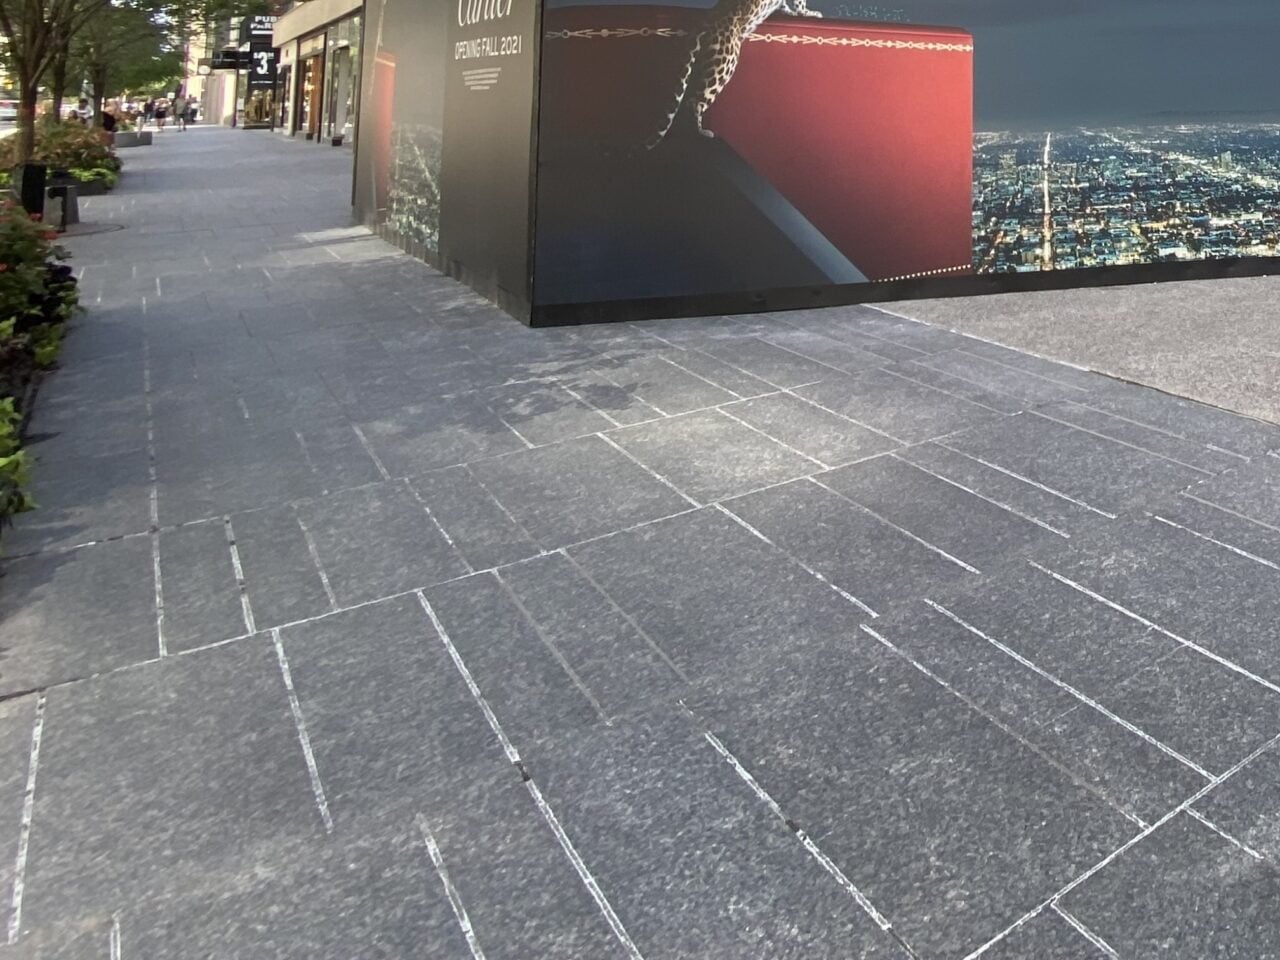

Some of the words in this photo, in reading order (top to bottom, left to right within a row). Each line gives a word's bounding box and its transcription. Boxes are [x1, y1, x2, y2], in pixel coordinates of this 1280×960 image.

[454, 39, 480, 60] OPENING
[481, 37, 499, 58] FALL
[500, 35, 522, 56] 2021
